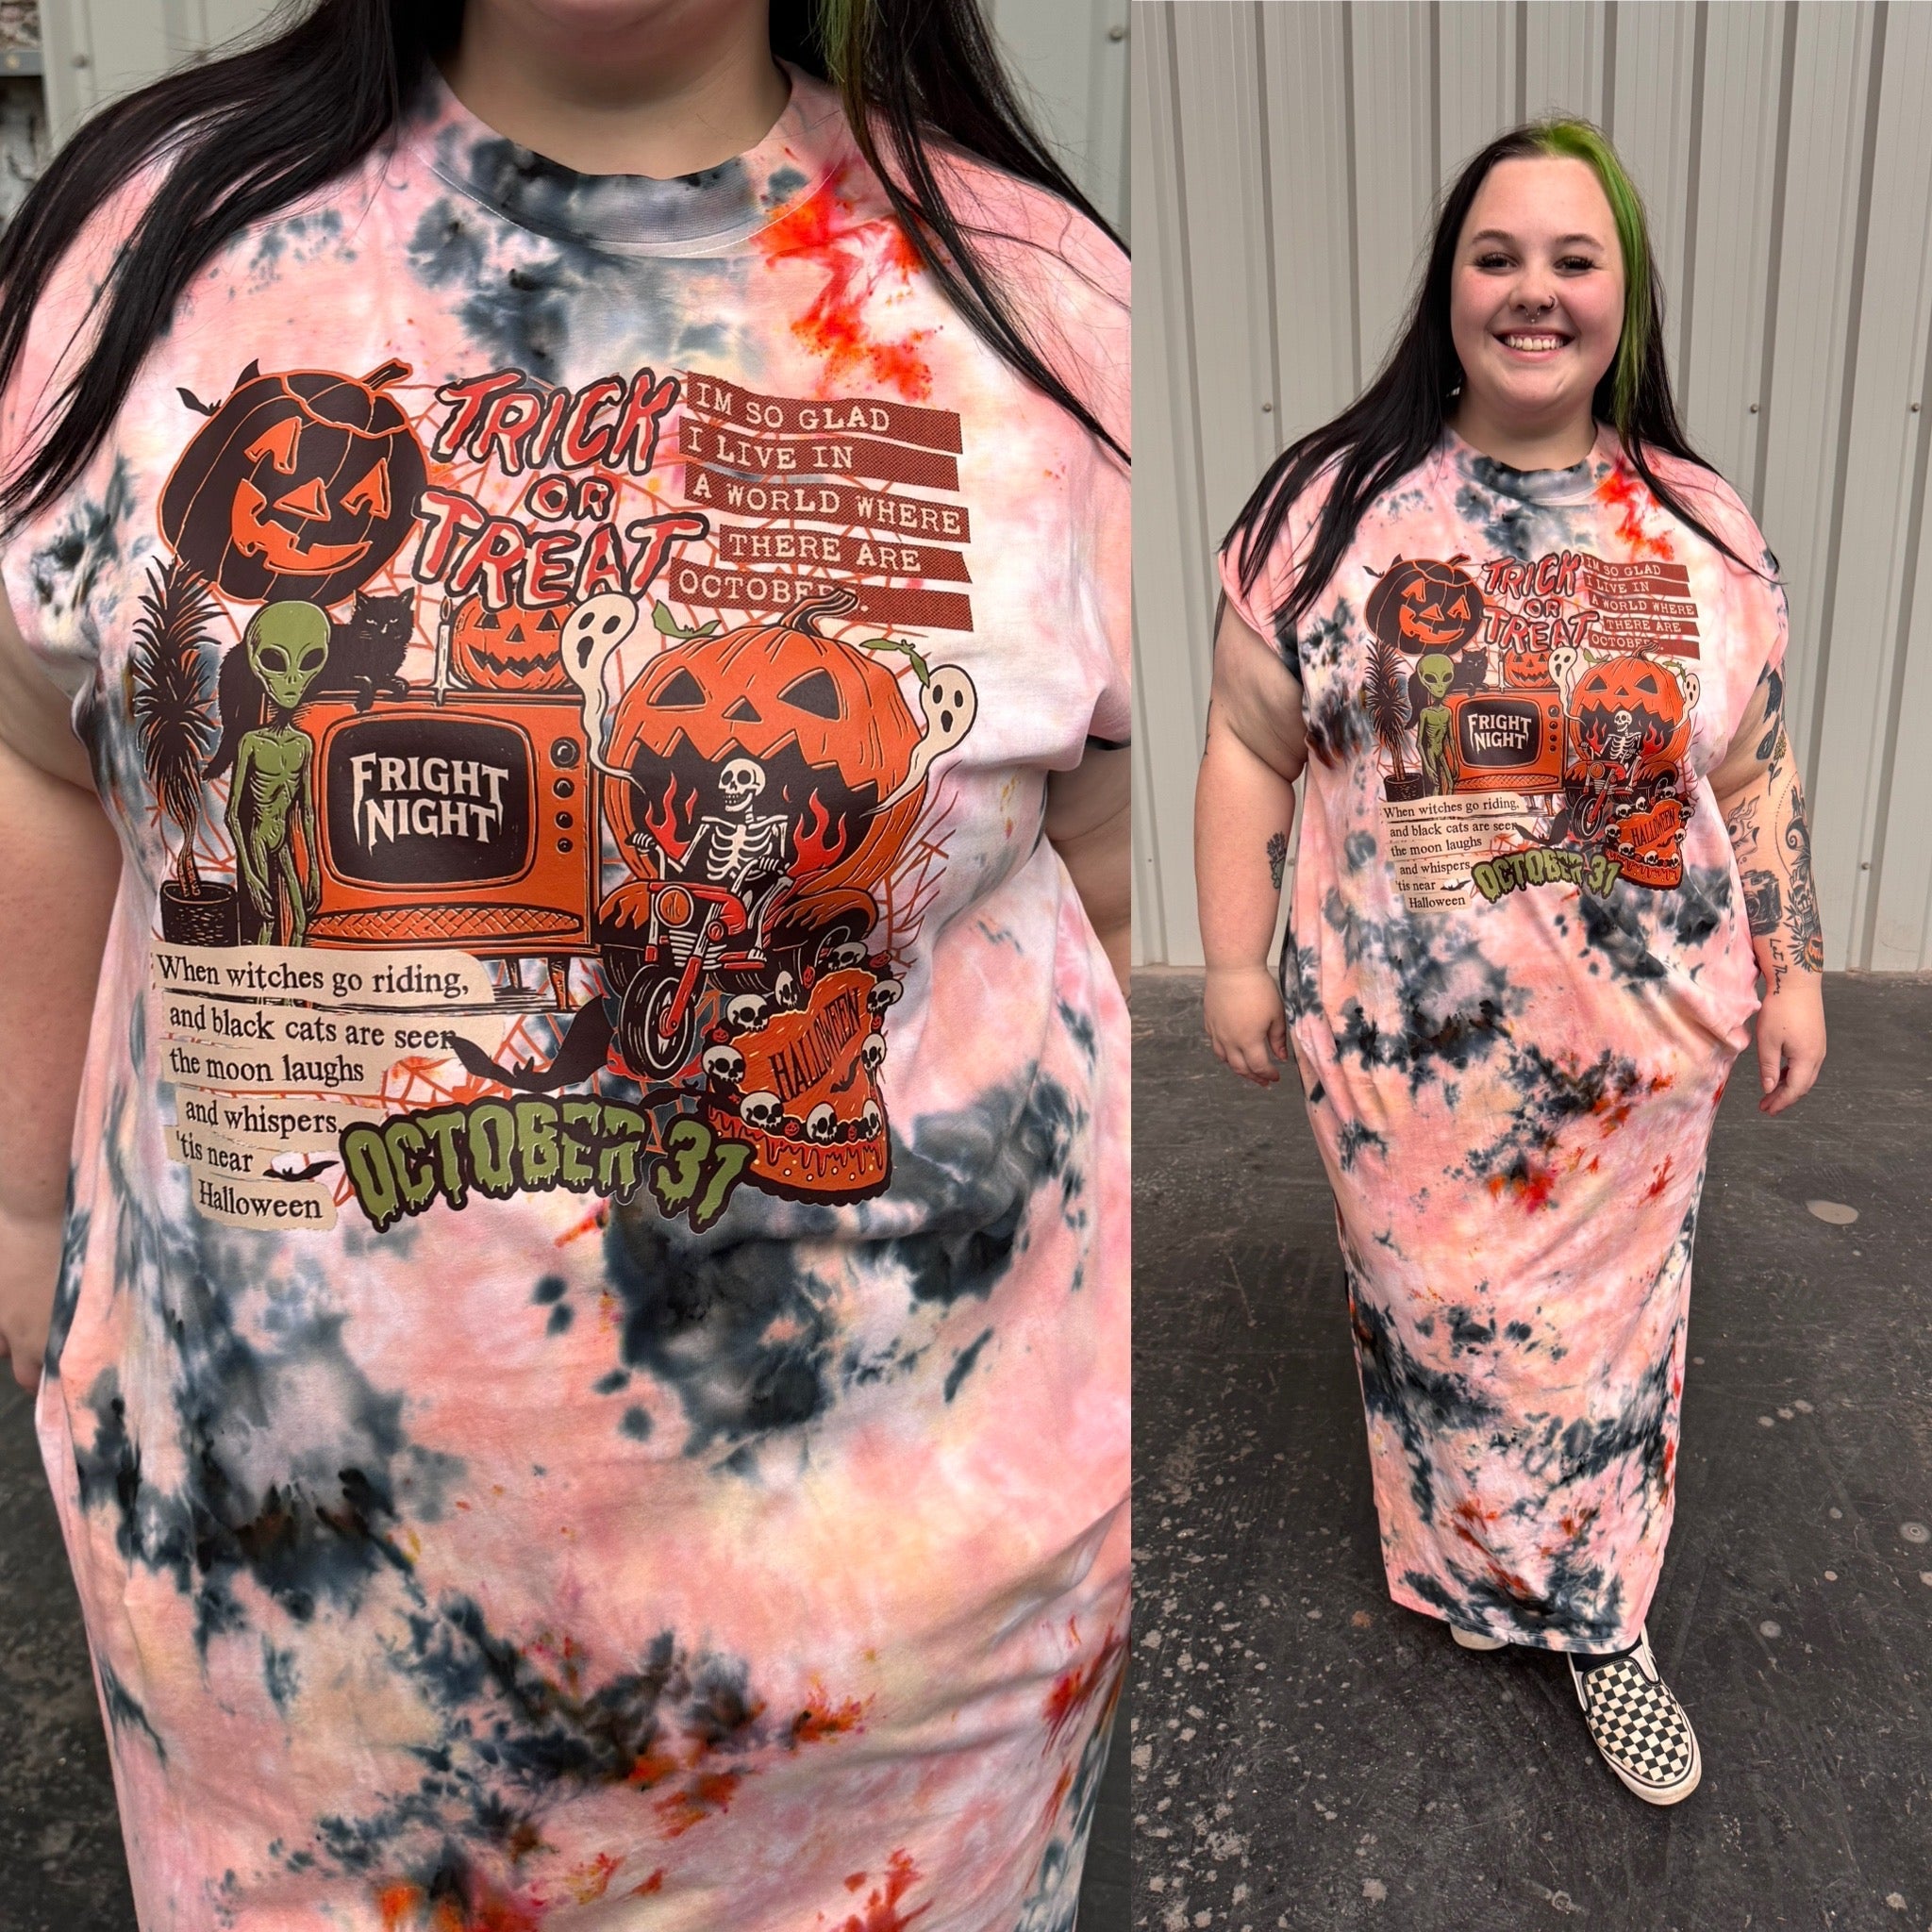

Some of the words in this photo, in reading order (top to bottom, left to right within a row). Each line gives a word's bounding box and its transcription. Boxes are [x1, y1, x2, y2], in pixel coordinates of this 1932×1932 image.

[431, 368, 680, 475] TRICK
[695, 382, 732, 416] IM
[746, 402, 784, 428] SO
[799, 406, 890, 431] GLAD
[688, 426, 704, 453] I
[717, 434, 796, 470] LIVE
[812, 445, 855, 469] IN
[525, 475, 614, 520] OR
[692, 473, 712, 498] A
[726, 482, 841, 513] WORLD
[857, 494, 961, 535] WHERE
[411, 485, 709, 613] TREAT
[728, 533, 841, 561] THERE
[857, 542, 922, 572] ARE
[1586, 557, 1601, 572] IM
[1604, 565, 1619, 576] SO
[1624, 564, 1661, 575] GLAD
[1482, 550, 1581, 600] TRICK
[1587, 575, 1592, 586] I
[1596, 578, 1627, 593] LIVE
[1632, 581, 1650, 592] IN
[1524, 598, 1560, 619] OR
[1591, 594, 1599, 606] A
[1603, 598, 1647, 611] WORLD
[1652, 601, 1695, 615] WHERE
[1481, 606, 1600, 655] TREAT
[1606, 619, 1651, 631] THERE
[1656, 621, 1682, 632] ARE
[1467, 712, 1532, 752] FRIGHT
[1474, 731, 1525, 755] NIGHT
[349, 752, 509, 846] FRIGHT
[1383, 807, 1415, 819] When
[1419, 802, 1462, 815] witches
[1465, 803, 1479, 813] go
[365, 798, 496, 858] NIGHT
[1390, 825, 1409, 838] and
[1411, 823, 1442, 837] black
[1445, 822, 1469, 833] cats
[1391, 845, 1407, 857] the
[1409, 843, 1442, 855] moon
[1446, 837, 1482, 853] laughs
[1630, 808, 1675, 847] HALLOWEEN
[1396, 880, 1410, 891] 'tis
[1412, 881, 1436, 891] near
[1399, 863, 1418, 875] and
[1471, 846, 1584, 904] OCTOBER
[1587, 853, 1624, 900] 31
[1408, 896, 1466, 908] Halloween
[156, 954, 221, 985] When
[226, 963, 324, 991] witches
[332, 972, 363, 997] go
[372, 964, 469, 998] riding,
[169, 1005, 207, 1031] and
[212, 1007, 275, 1041] black
[285, 1018, 337, 1042] cats
[345, 1027, 385, 1046] are
[394, 1028, 457, 1049] seen
[768, 987, 861, 1103] HALLOWEEN
[169, 1048, 201, 1074] the
[206, 1061, 275, 1083] moon
[281, 1054, 364, 1088] laughs
[186, 1100, 219, 1127] and
[175, 1131, 203, 1161] 'tis
[207, 1147, 254, 1173] near
[340, 1096, 648, 1232] OCTOBER
[649, 1111, 751, 1234] 31
[198, 1179, 324, 1219] Halloween
